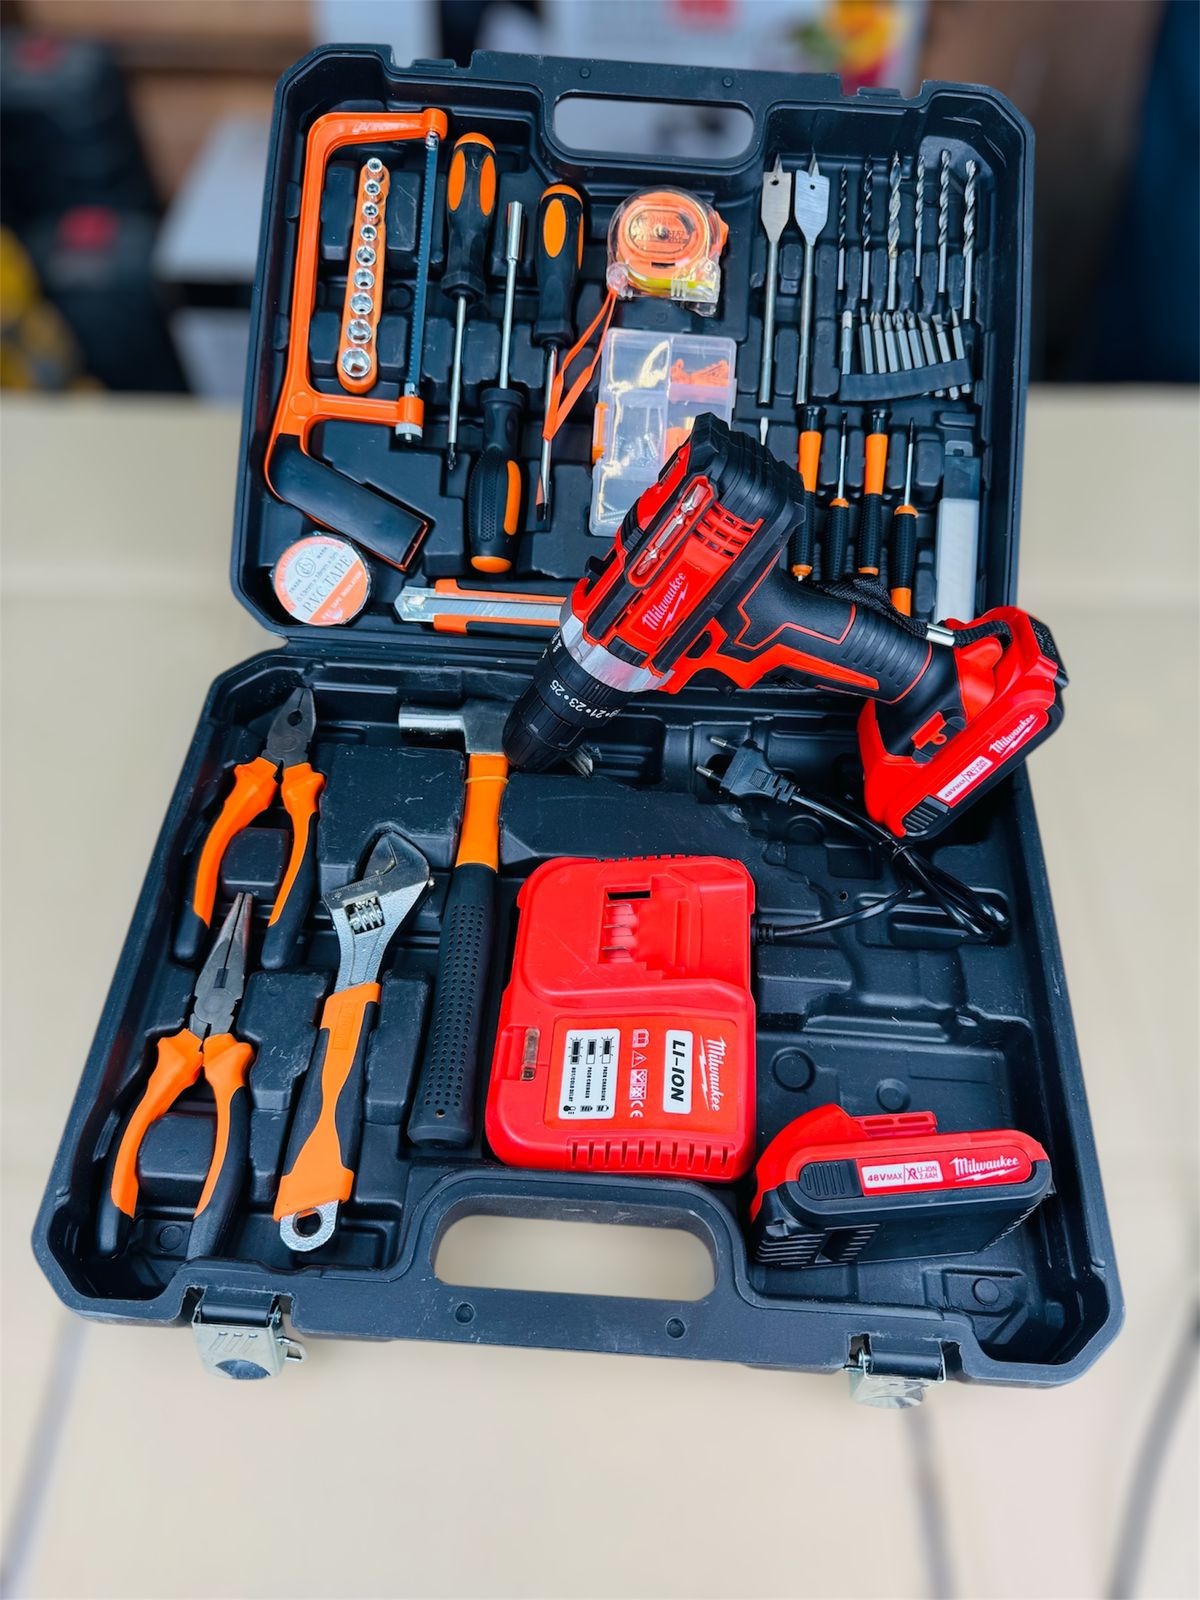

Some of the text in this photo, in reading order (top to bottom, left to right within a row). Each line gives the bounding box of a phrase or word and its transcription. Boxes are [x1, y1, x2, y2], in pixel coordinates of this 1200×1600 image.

[321, 554, 352, 587] TAPE
[642, 572, 686, 630] Milwaukee
[549, 679, 565, 696] 25
[568, 697, 587, 712] 23
[589, 708, 607, 718] 21
[988, 713, 1035, 753] Milwaukee
[670, 1039, 685, 1102] LI-ION
[707, 1035, 727, 1112] Milwaukee
[949, 1155, 1019, 1176] Milwaukee
